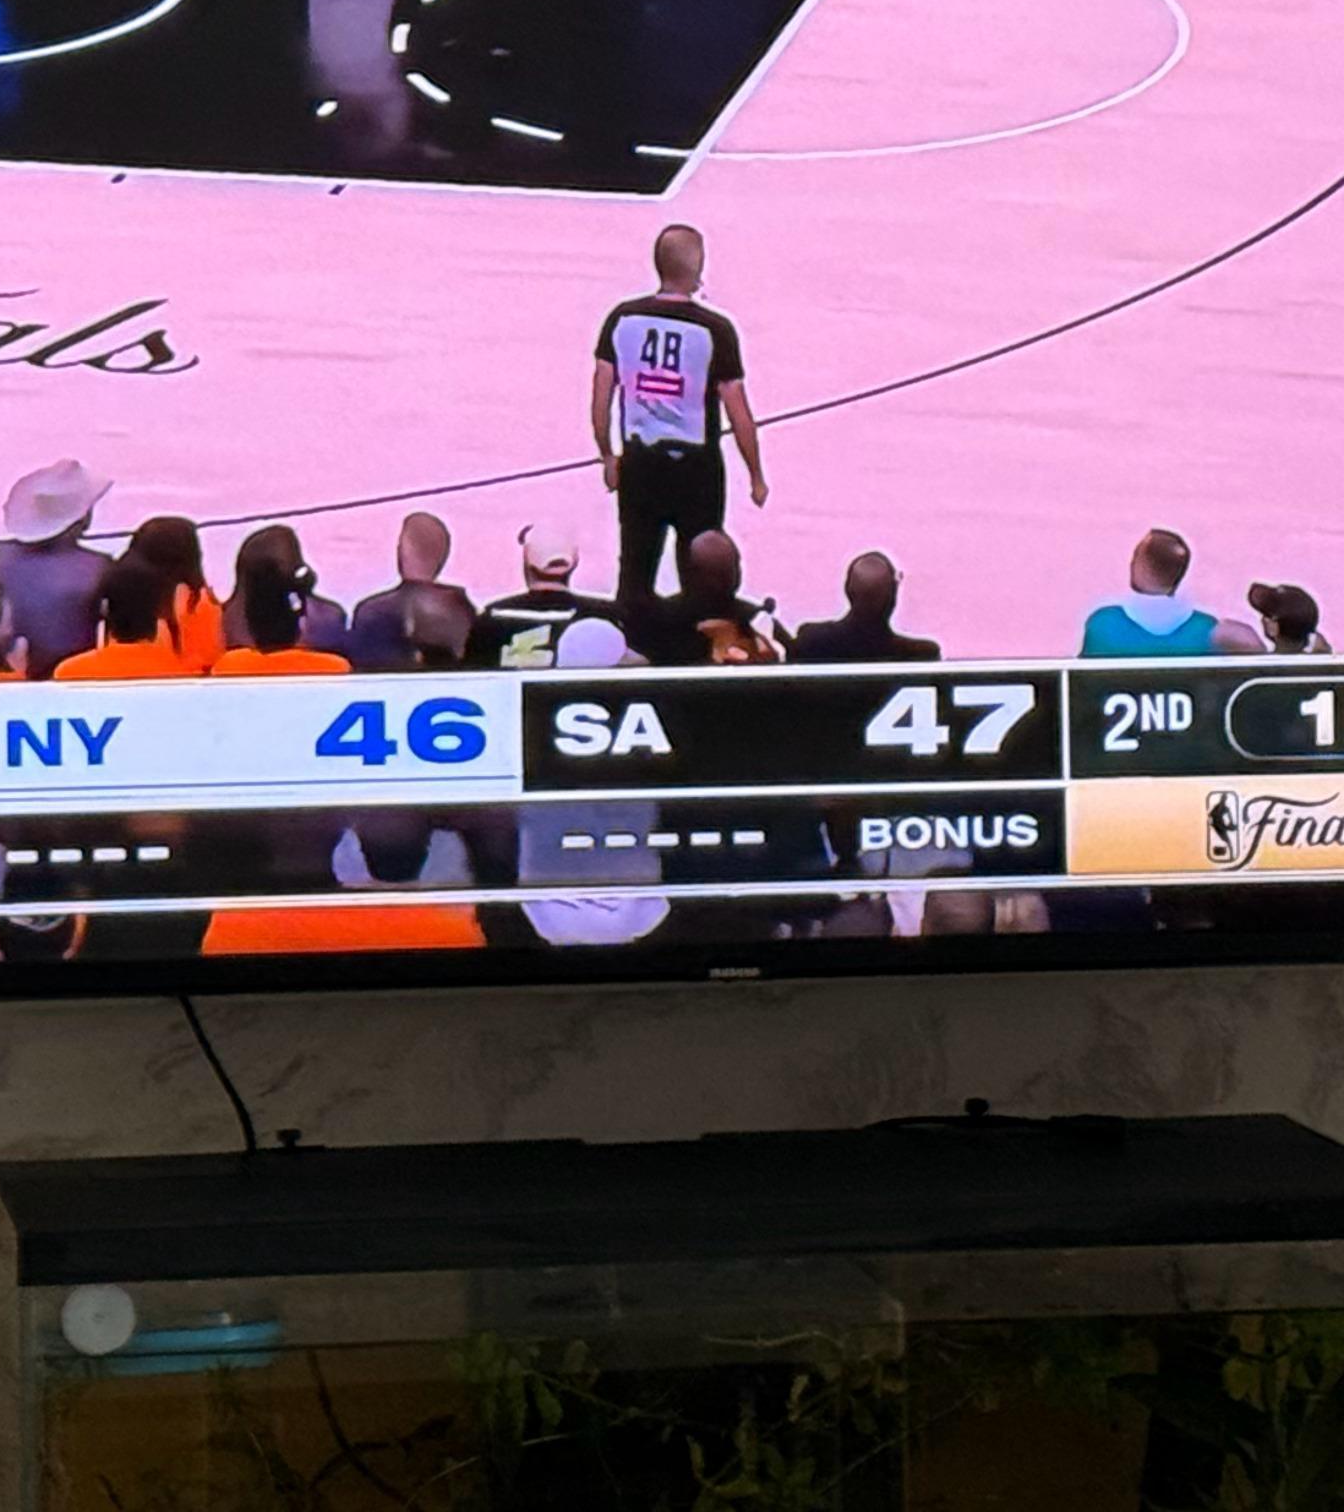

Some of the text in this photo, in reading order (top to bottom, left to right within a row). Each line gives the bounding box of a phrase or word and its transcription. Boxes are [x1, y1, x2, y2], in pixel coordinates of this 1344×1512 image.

[5, 697, 488, 768] NY 46
[553, 684, 1036, 758] SA 47
[1102, 691, 1194, 753] 2ND
[860, 814, 1040, 852] BONUS
